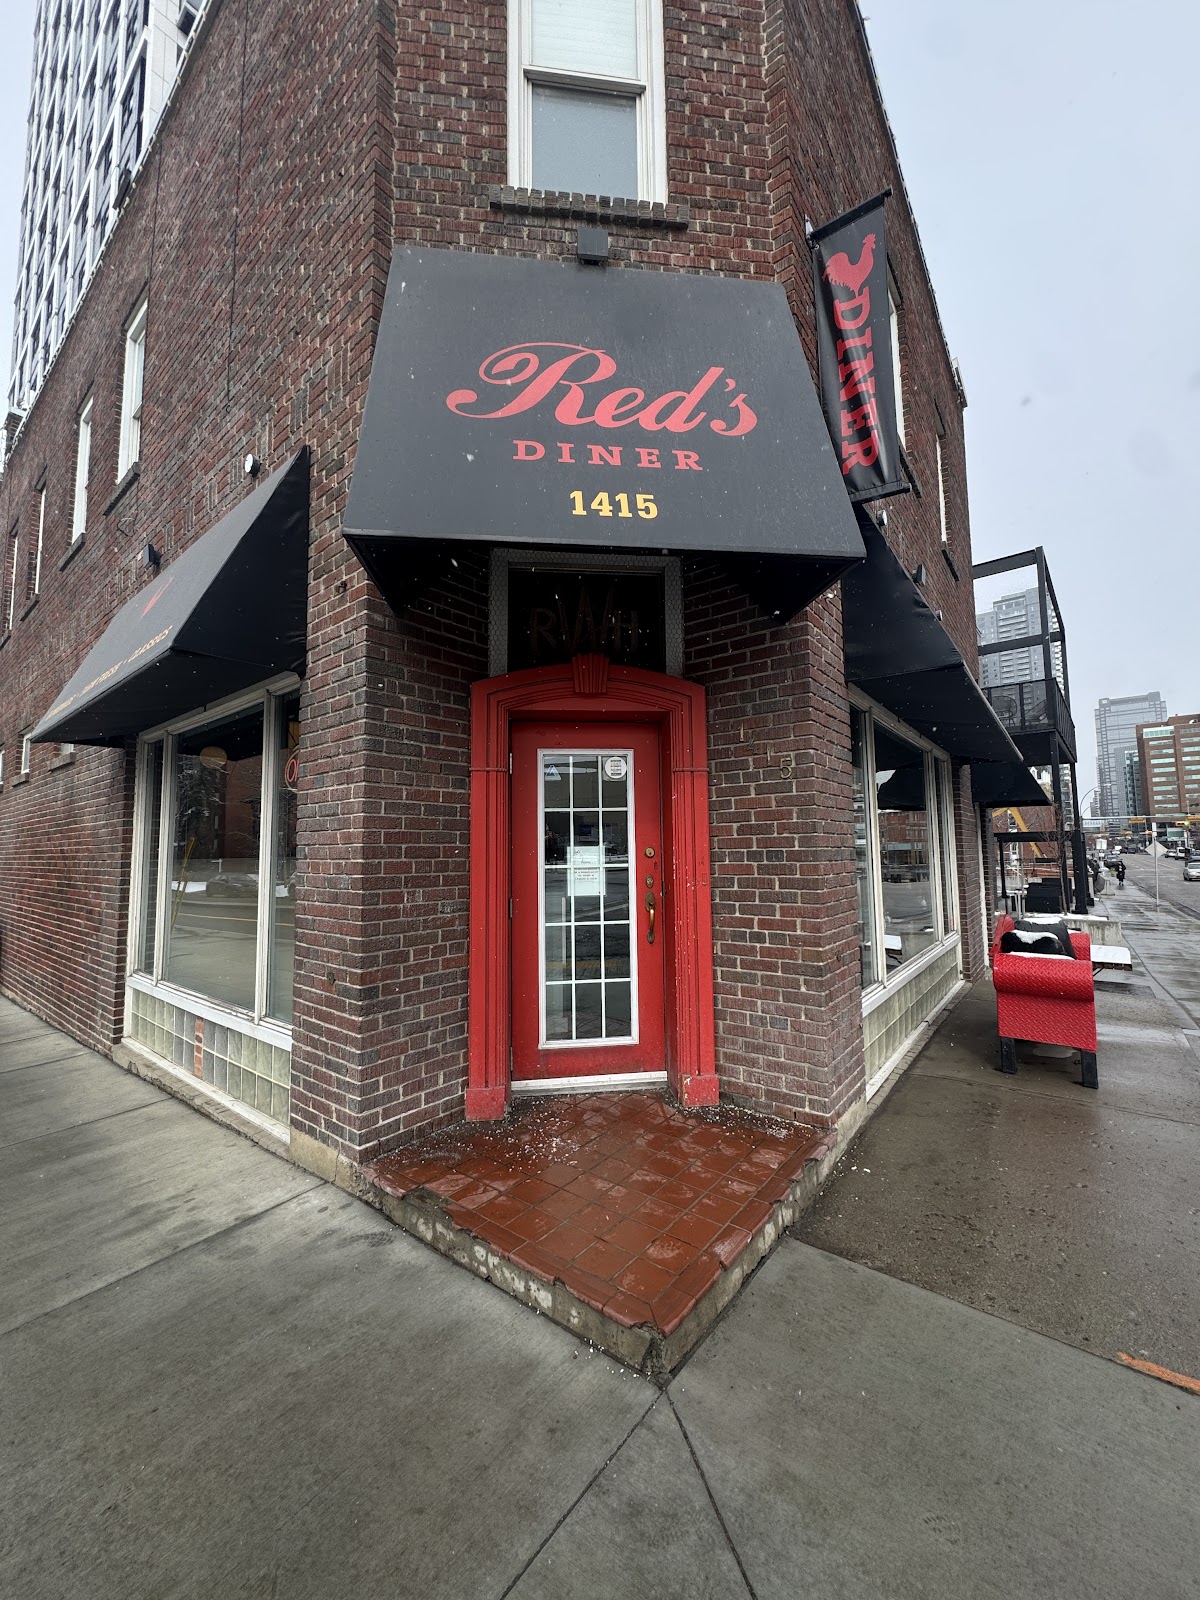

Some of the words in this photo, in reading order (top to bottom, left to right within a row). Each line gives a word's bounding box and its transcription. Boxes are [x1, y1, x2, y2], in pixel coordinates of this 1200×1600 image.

[445, 341, 758, 437] Red's
[833, 286, 879, 475] DINER
[512, 439, 703, 471] DINER
[569, 490, 658, 520] 1415
